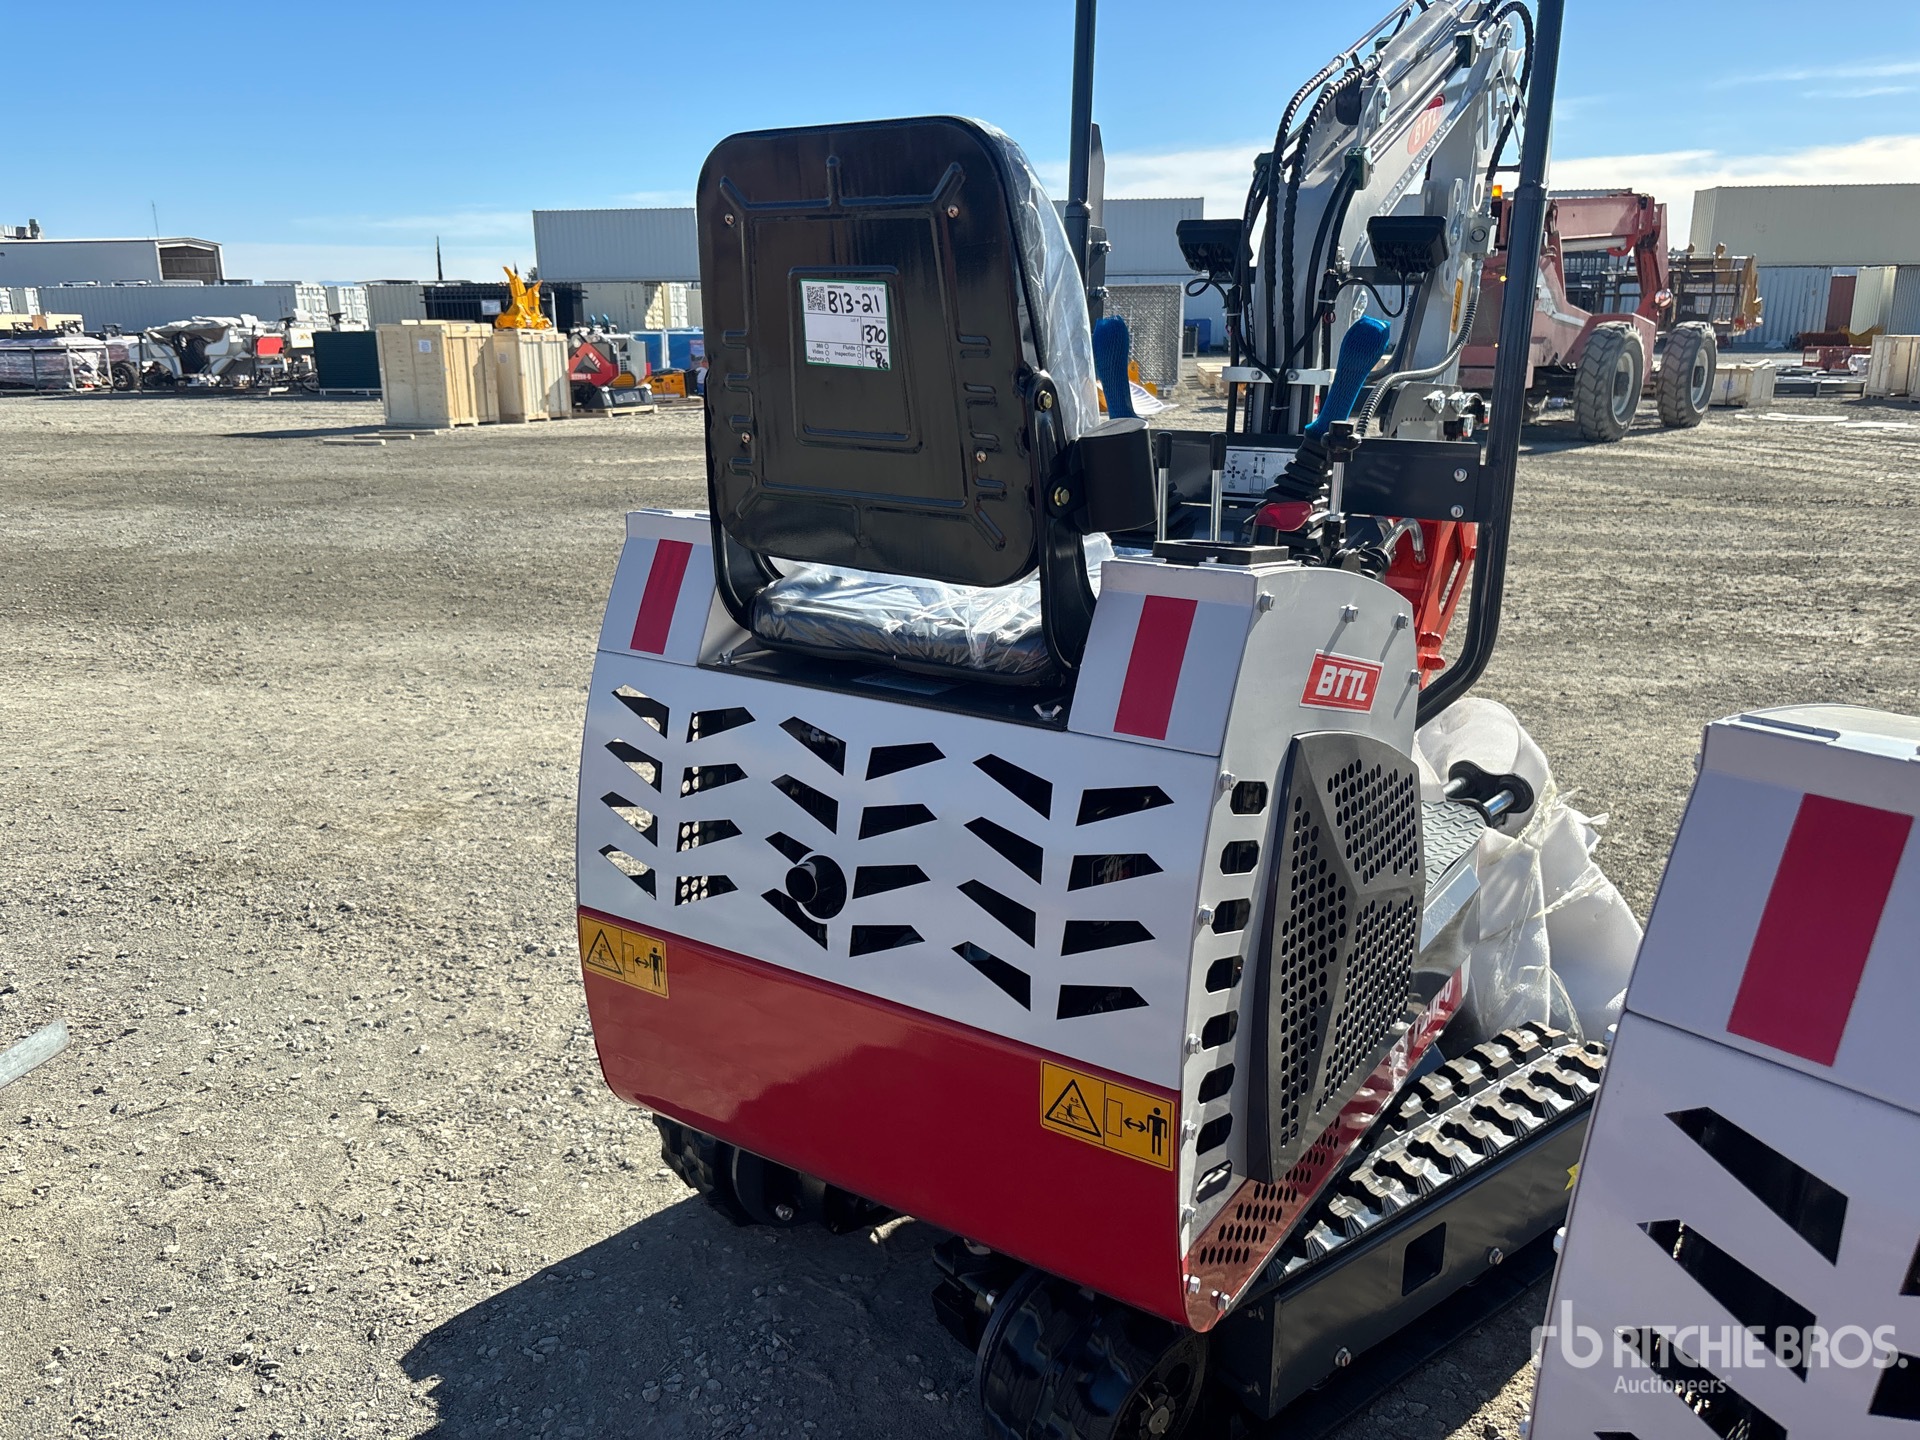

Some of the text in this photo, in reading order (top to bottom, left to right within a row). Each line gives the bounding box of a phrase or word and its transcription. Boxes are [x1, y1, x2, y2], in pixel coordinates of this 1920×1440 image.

[1414, 109, 1438, 146] BTTL
[828, 291, 880, 313] B13-21
[1315, 664, 1368, 702] BTTL
